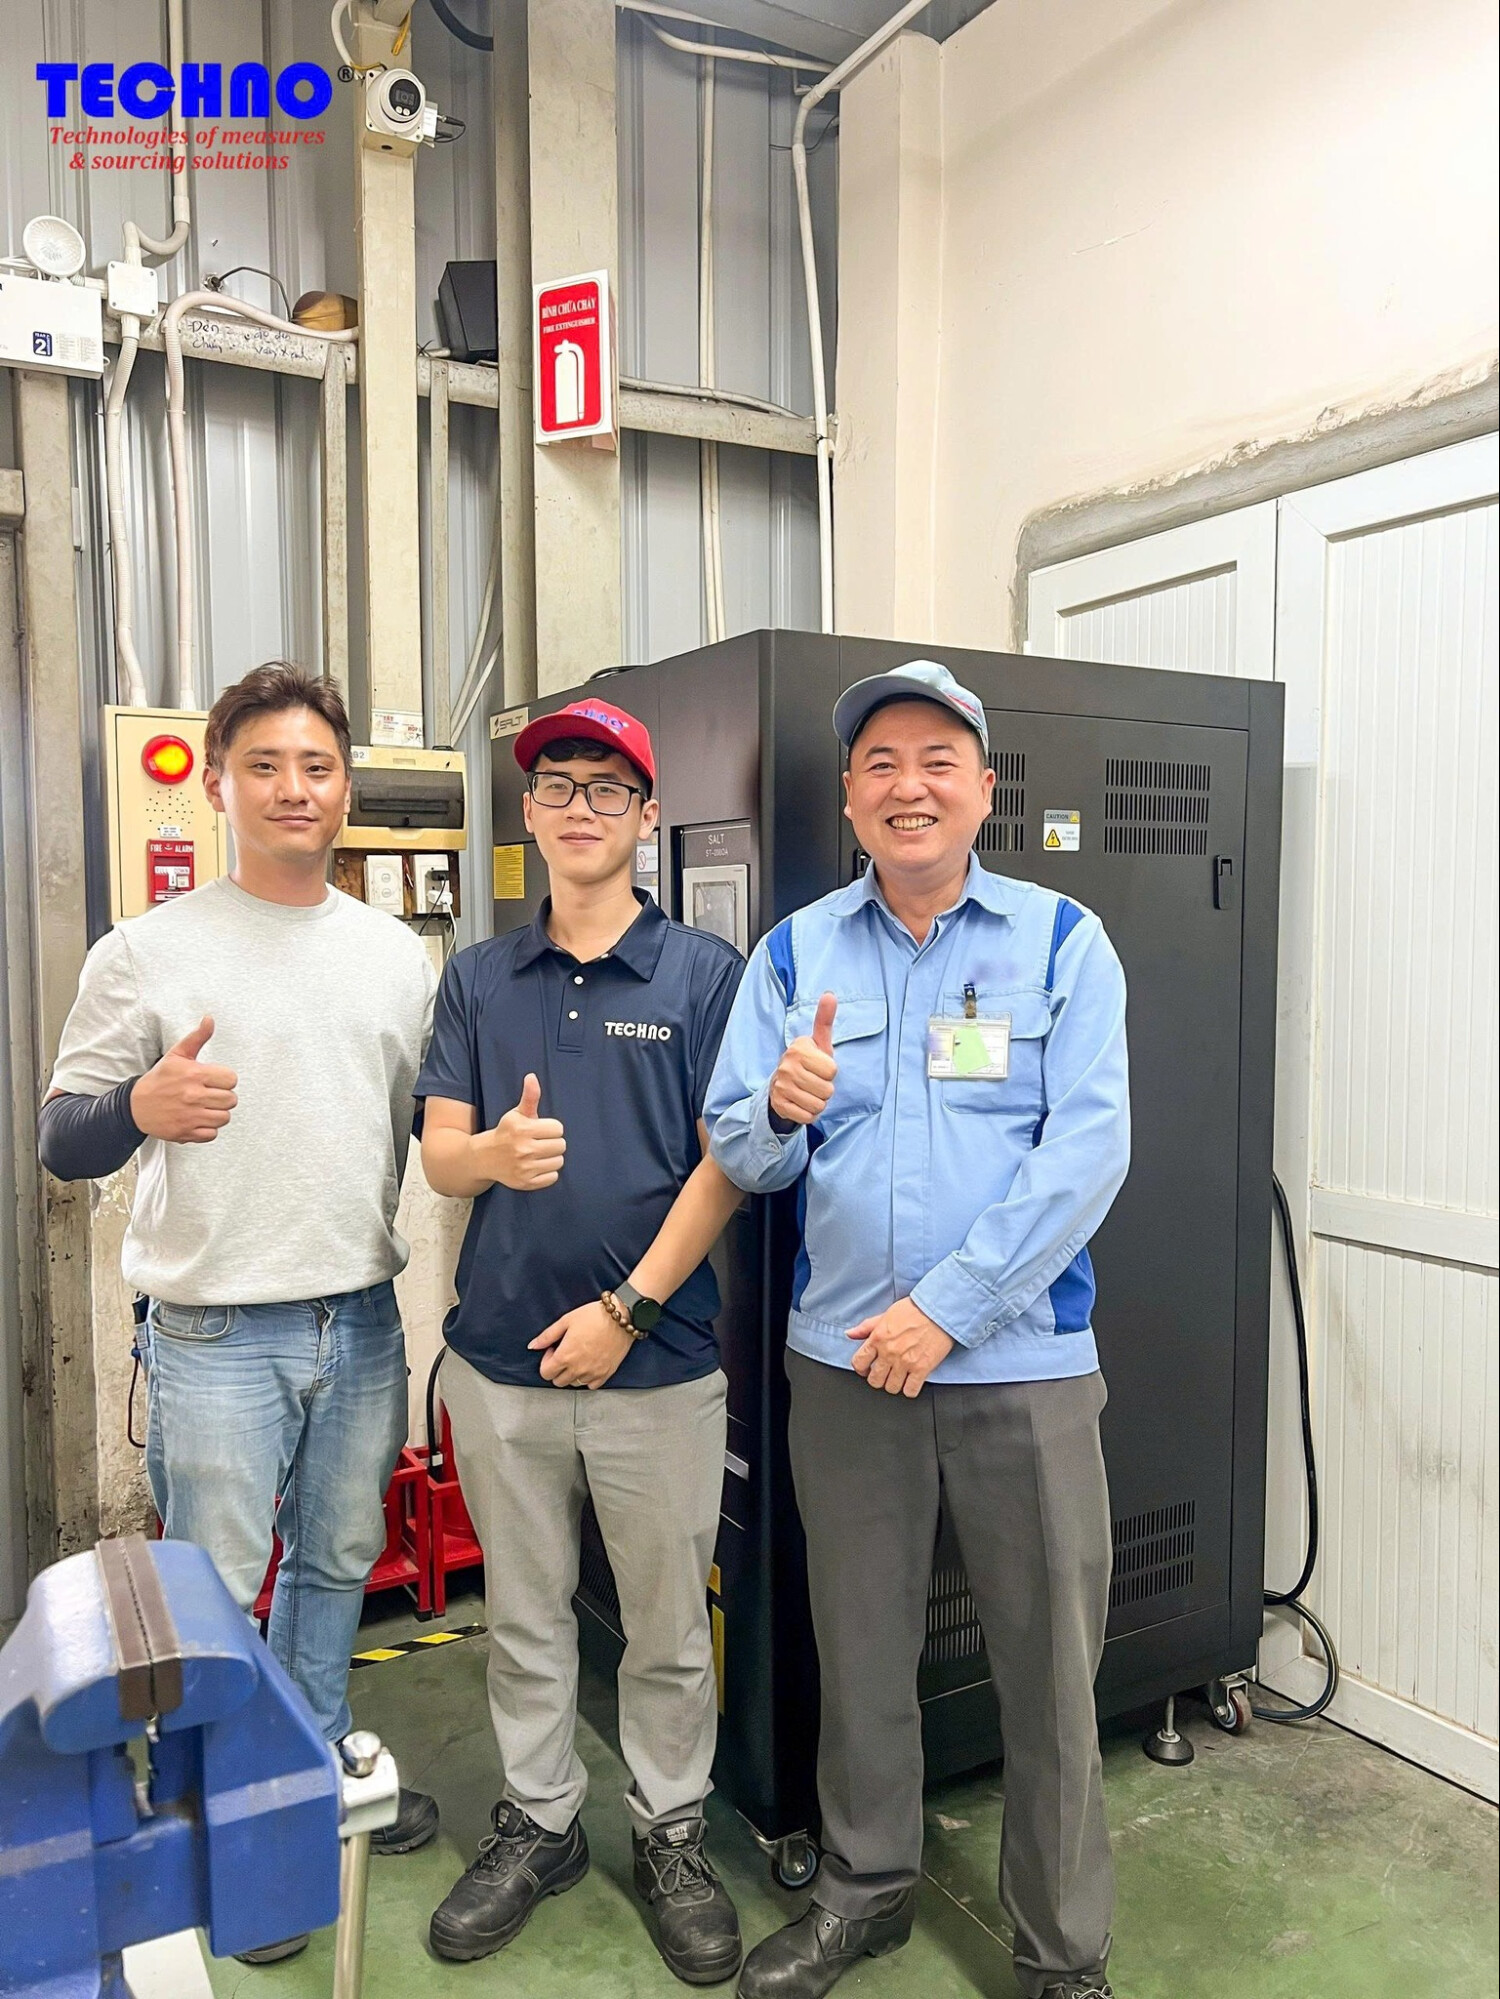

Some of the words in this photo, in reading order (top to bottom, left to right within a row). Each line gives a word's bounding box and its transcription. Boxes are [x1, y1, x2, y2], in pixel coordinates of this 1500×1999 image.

[35, 338, 47, 355] 2
[708, 833, 725, 845] SALT
[150, 844, 162, 853] FIRE
[174, 844, 194, 853] ALARM
[604, 1021, 672, 1041] TECHNO
